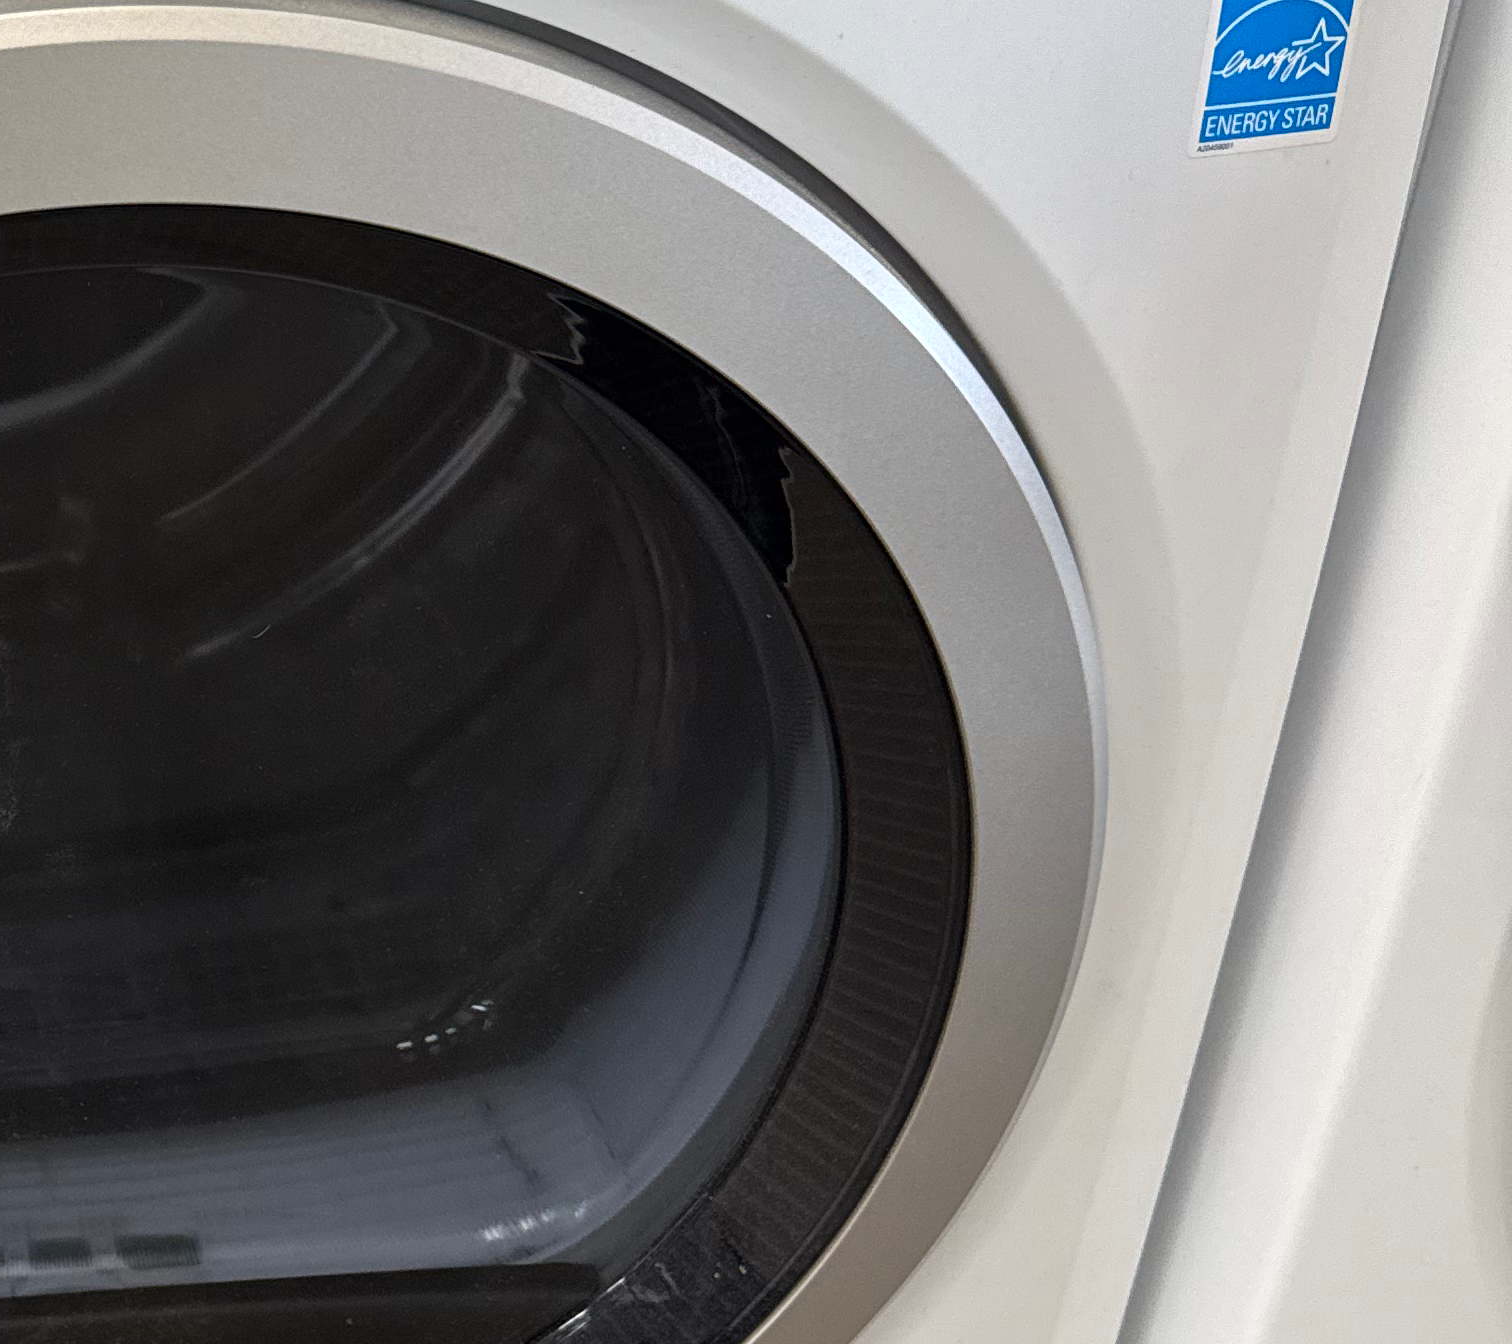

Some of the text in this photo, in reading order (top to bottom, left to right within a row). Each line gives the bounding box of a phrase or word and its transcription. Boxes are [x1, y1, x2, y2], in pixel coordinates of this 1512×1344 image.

[1214, 45, 1317, 82] energy
[1205, 111, 1280, 136] ENERGY
[1282, 104, 1328, 127] STAR
